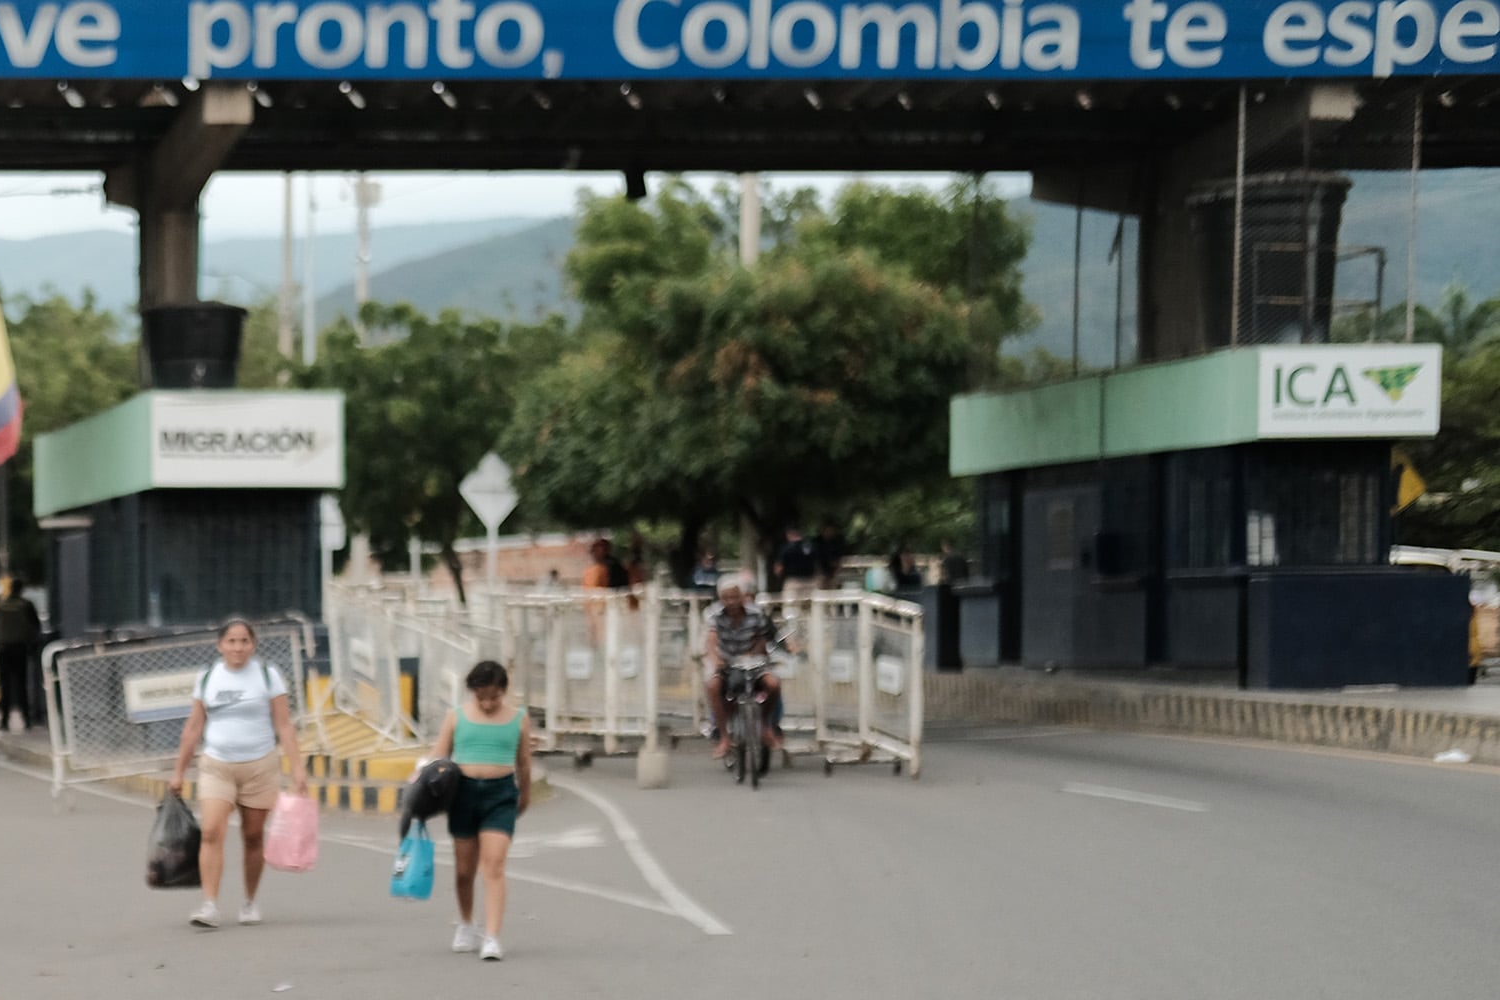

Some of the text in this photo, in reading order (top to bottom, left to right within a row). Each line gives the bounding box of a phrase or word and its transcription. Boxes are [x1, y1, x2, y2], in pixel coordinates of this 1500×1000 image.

[188, 0, 564, 79] pronto,
[613, 0, 1079, 71] Colombia
[1125, 0, 1227, 68] te
[1263, 0, 1500, 78] espe
[1274, 364, 1356, 406] ICA
